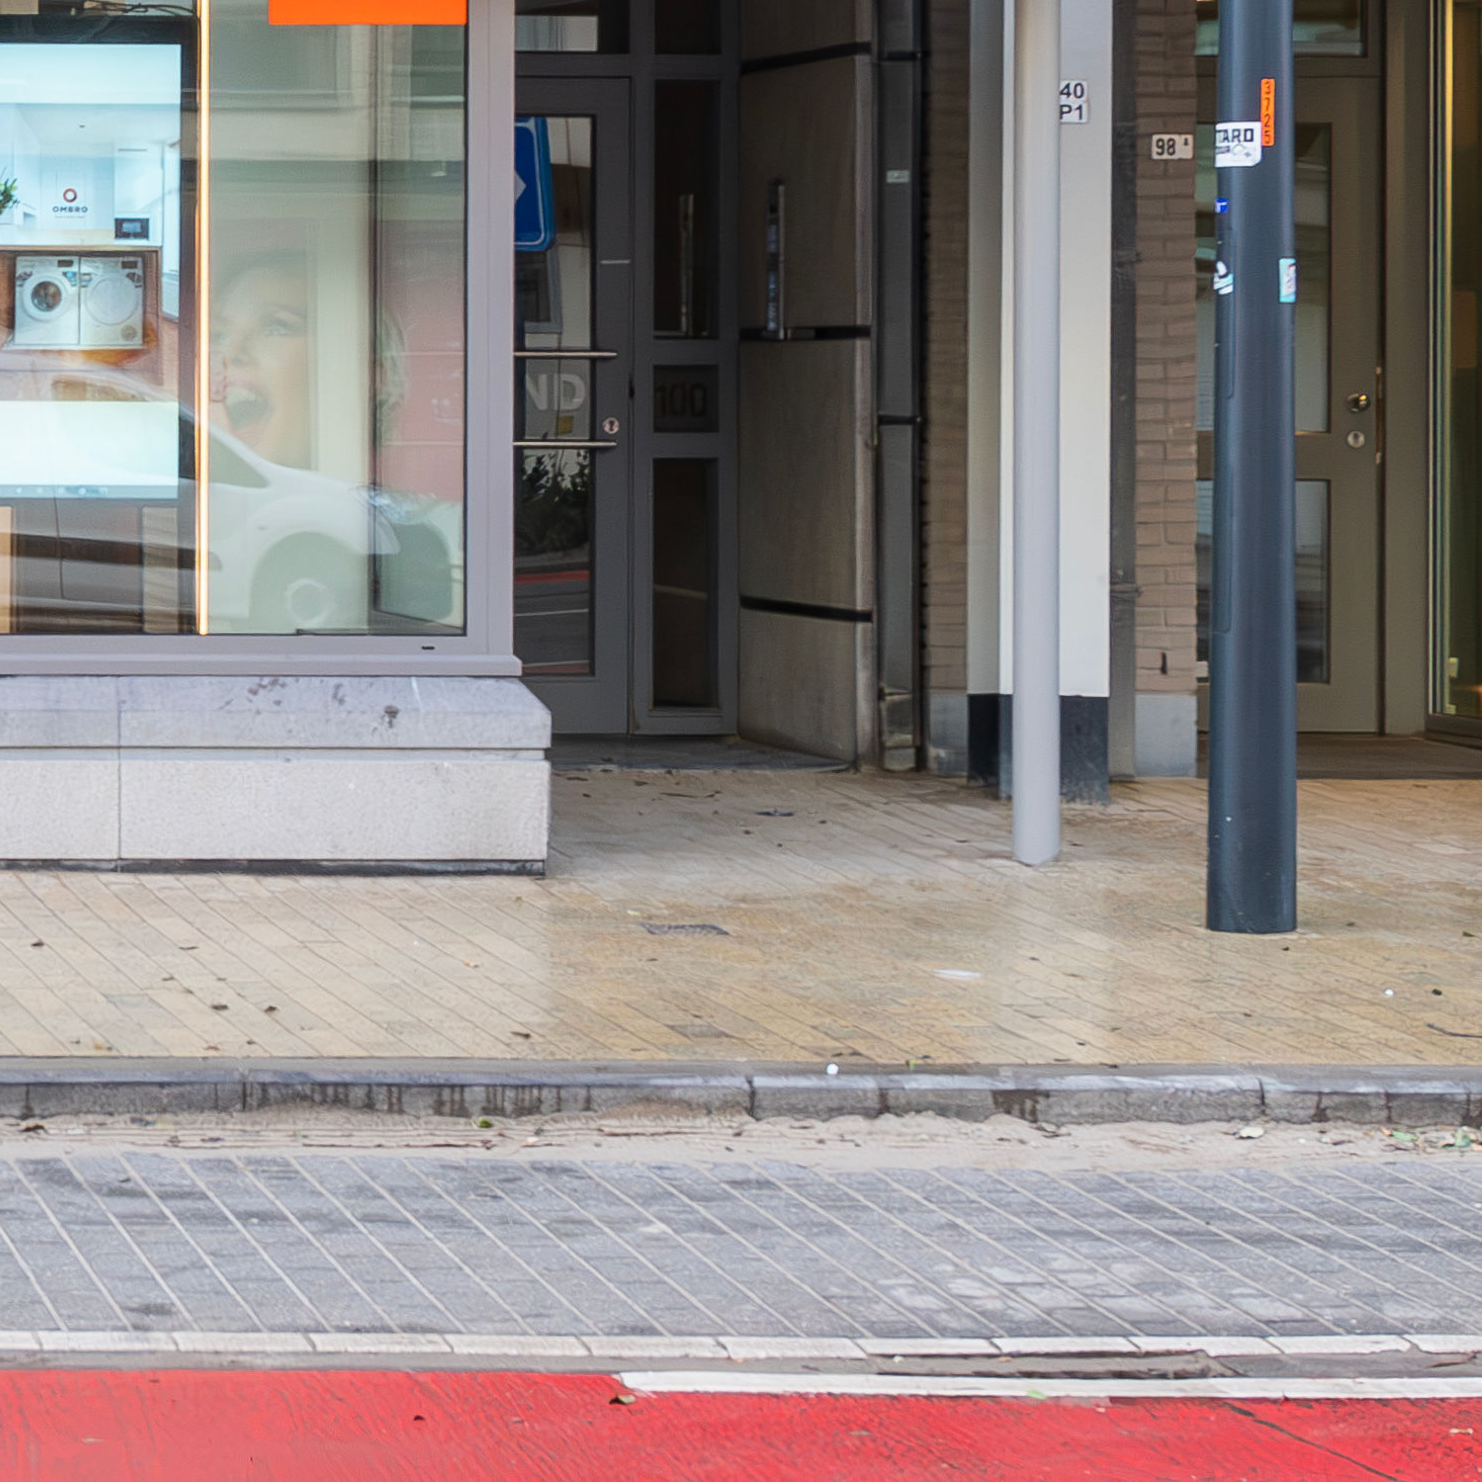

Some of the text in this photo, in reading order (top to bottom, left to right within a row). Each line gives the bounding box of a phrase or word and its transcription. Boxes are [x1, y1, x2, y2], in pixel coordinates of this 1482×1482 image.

[1059, 82, 1085, 99] 40
[1059, 104, 1082, 120] P1
[1155, 138, 1176, 156] 98
